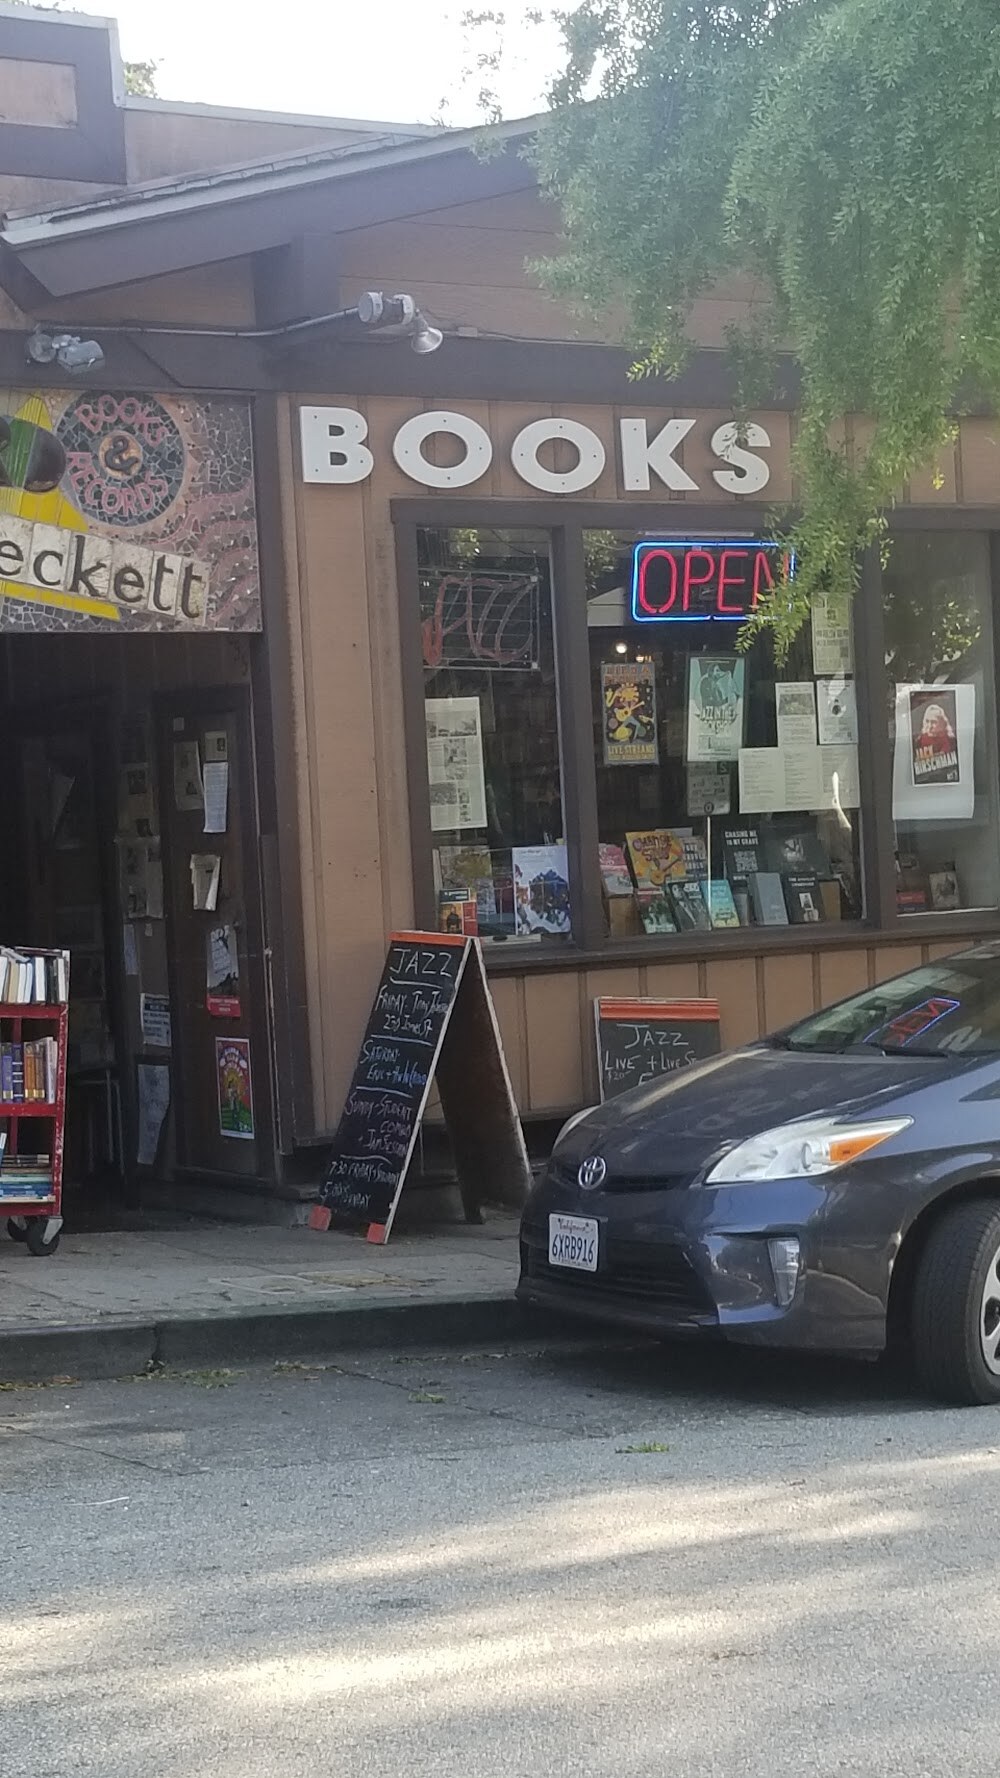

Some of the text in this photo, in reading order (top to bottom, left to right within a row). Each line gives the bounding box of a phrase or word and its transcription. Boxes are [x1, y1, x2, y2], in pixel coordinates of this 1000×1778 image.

[74, 394, 169, 446] BOOKS
[299, 406, 771, 494] BOOKS
[66, 451, 168, 517] RECORDS
[639, 549, 790, 614] OPEN
[389, 948, 452, 978] JAZZ
[616, 1023, 689, 1049] JAZZ
[604, 1050, 641, 1071] LIVE
[661, 1051, 680, 1070] LIVE
[552, 1233, 595, 1263] 6XRB916
